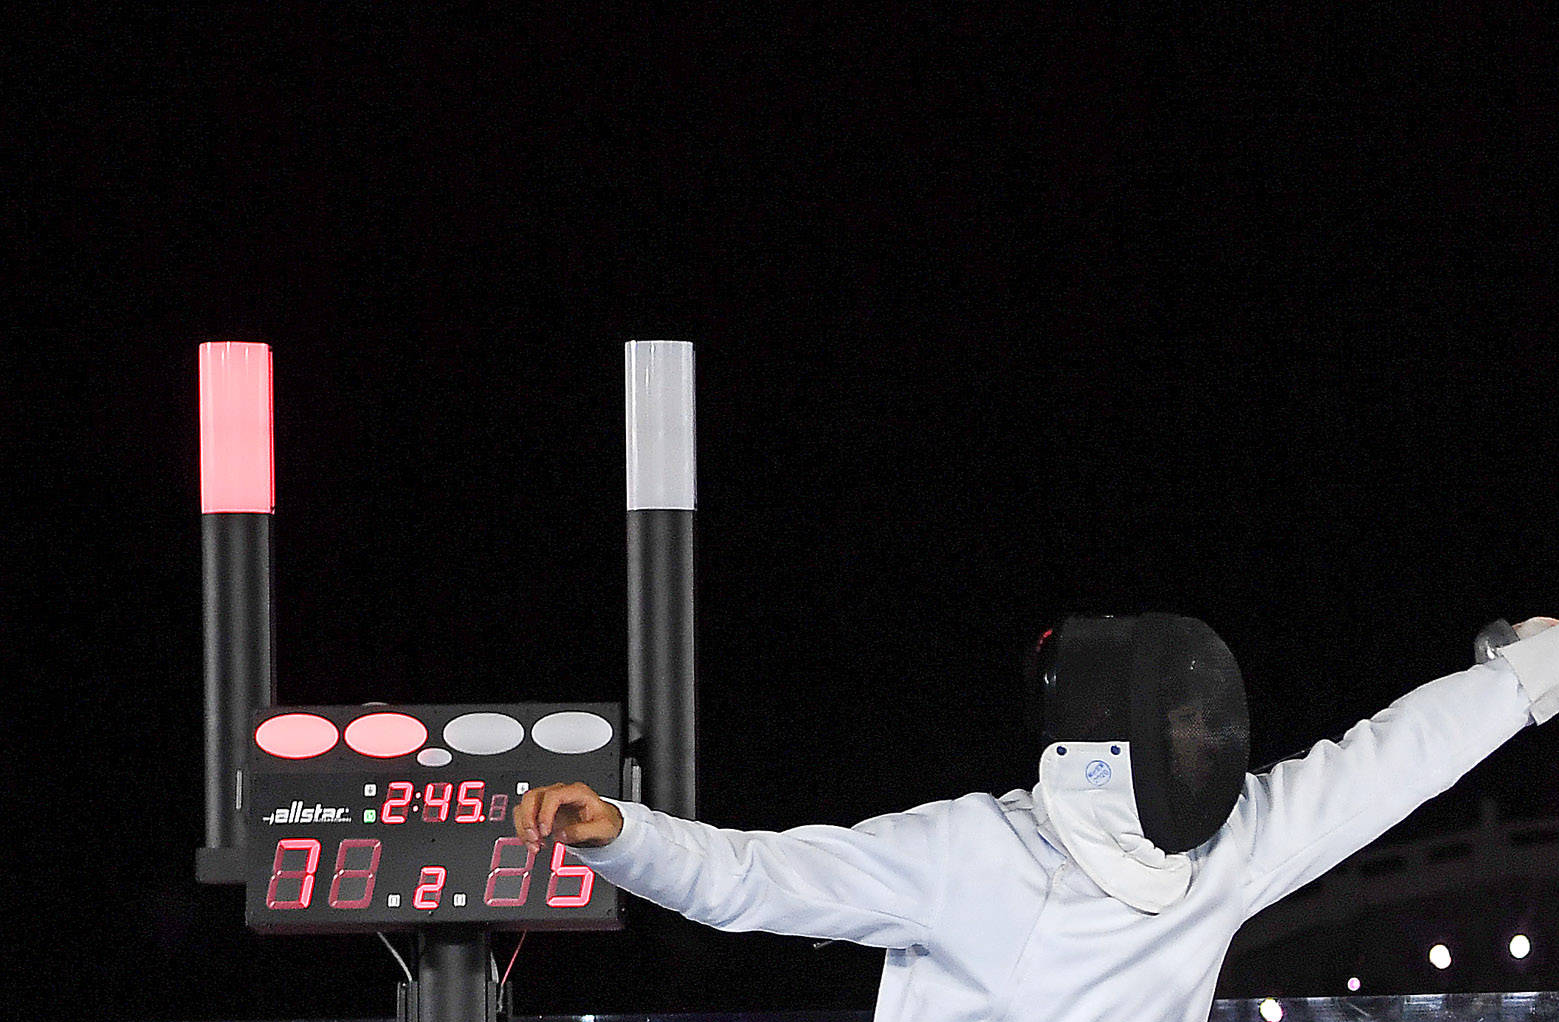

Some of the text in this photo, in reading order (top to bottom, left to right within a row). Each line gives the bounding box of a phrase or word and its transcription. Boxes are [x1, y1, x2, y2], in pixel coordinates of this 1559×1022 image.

[274, 800, 345, 824] allstar
[275, 838, 321, 909] 7
[413, 866, 447, 910] 2
